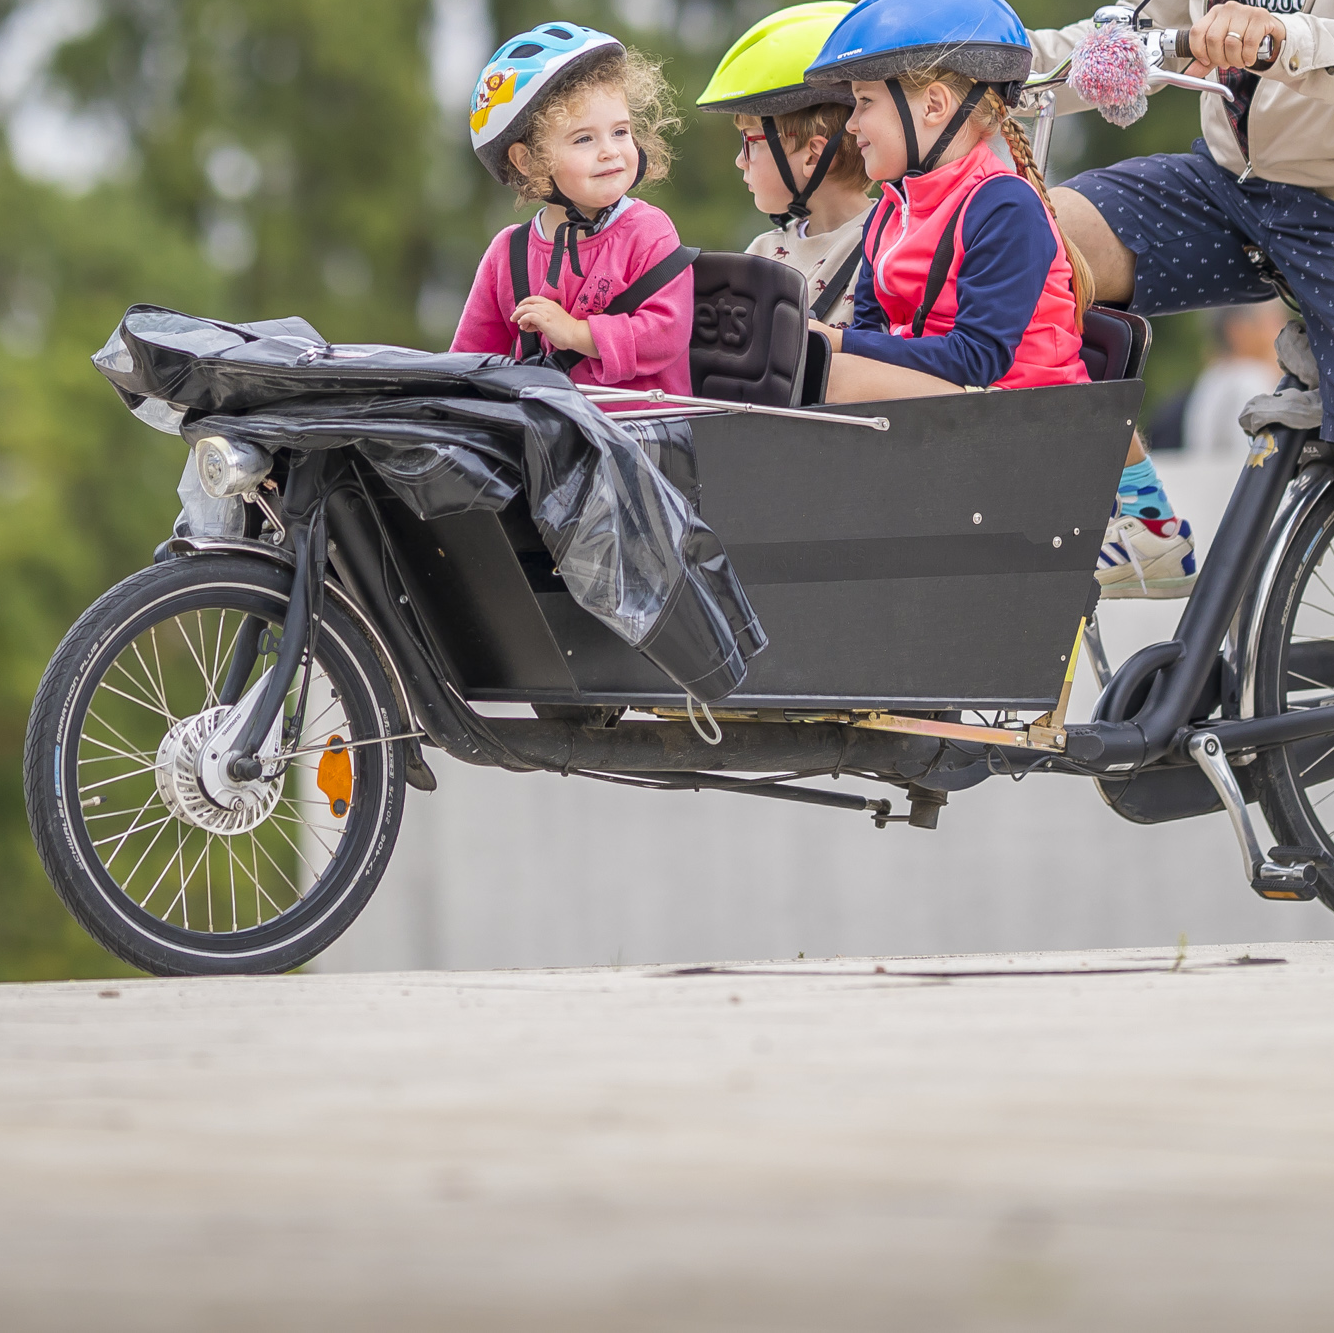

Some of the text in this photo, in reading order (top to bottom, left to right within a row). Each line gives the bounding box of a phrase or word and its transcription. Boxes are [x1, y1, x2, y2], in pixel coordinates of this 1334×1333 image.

[55, 641, 100, 871] SCHWALBE MARATHON PLUS
[365, 833, 386, 877] 47-406
